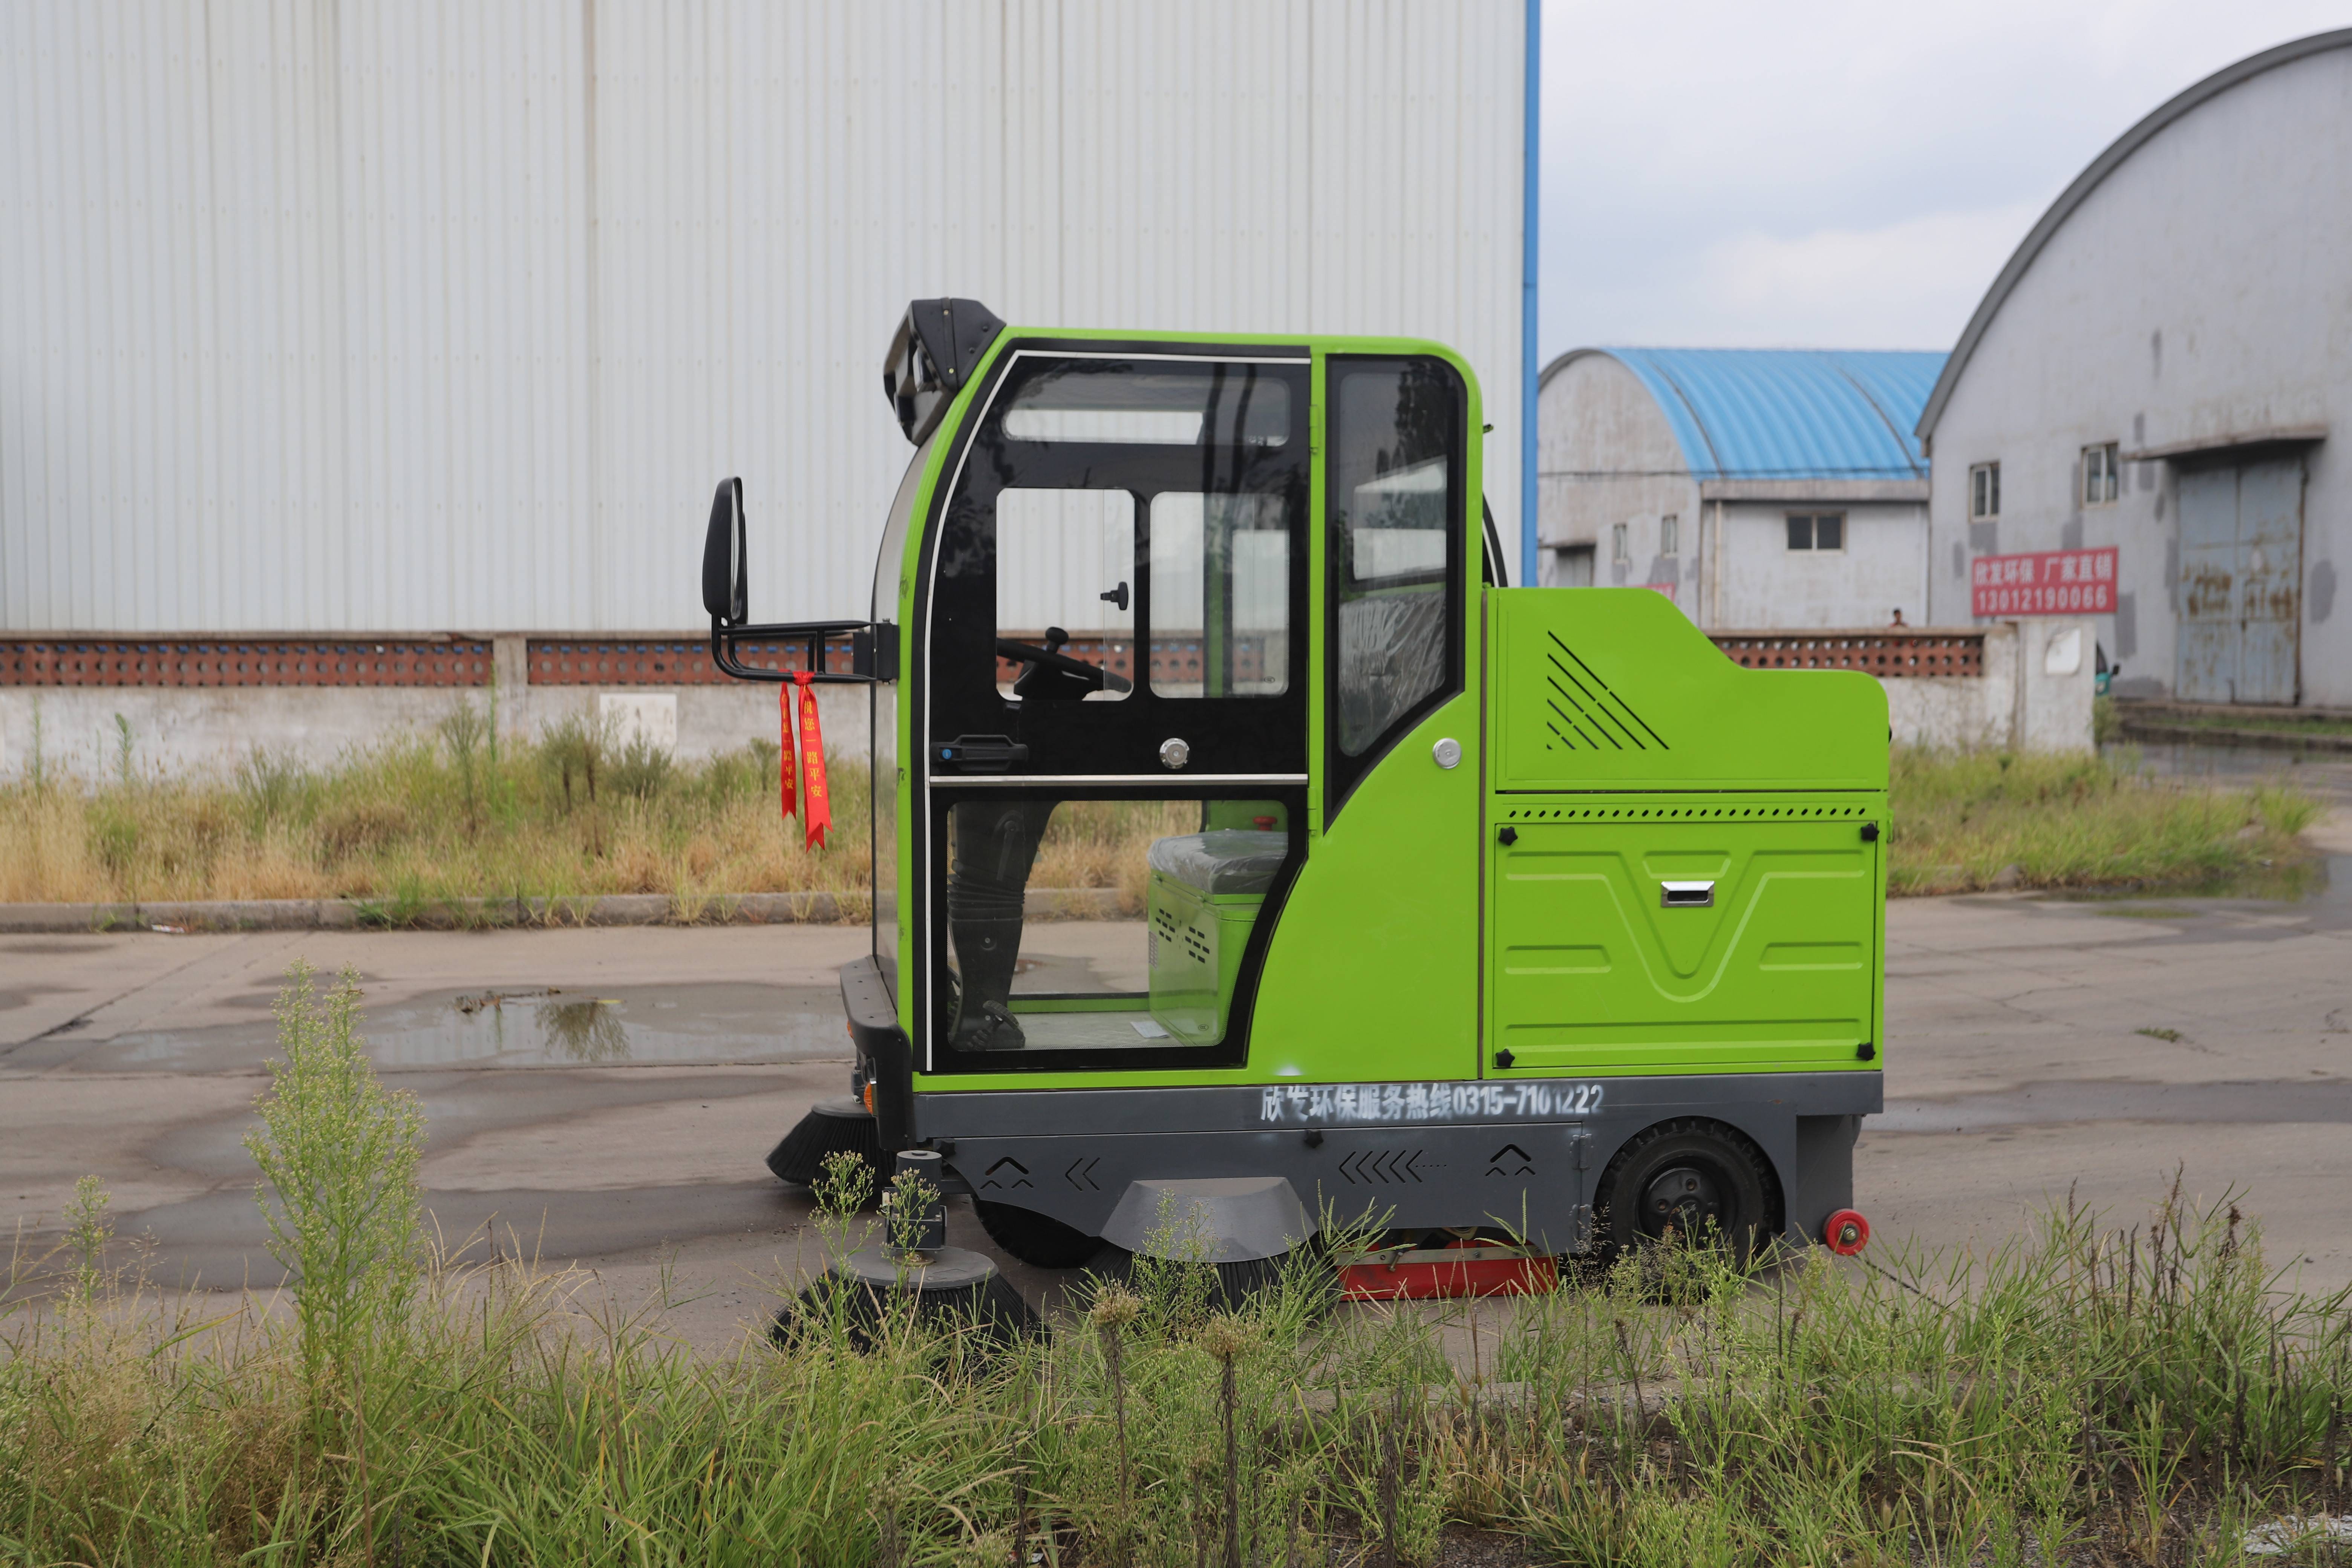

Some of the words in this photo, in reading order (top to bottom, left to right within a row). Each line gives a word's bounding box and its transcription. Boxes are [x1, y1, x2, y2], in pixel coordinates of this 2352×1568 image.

[2043, 552, 2113, 583] 厂家直销
[1978, 585, 2107, 612] 13012190066
[804, 700, 822, 797] 祝您一路平安
